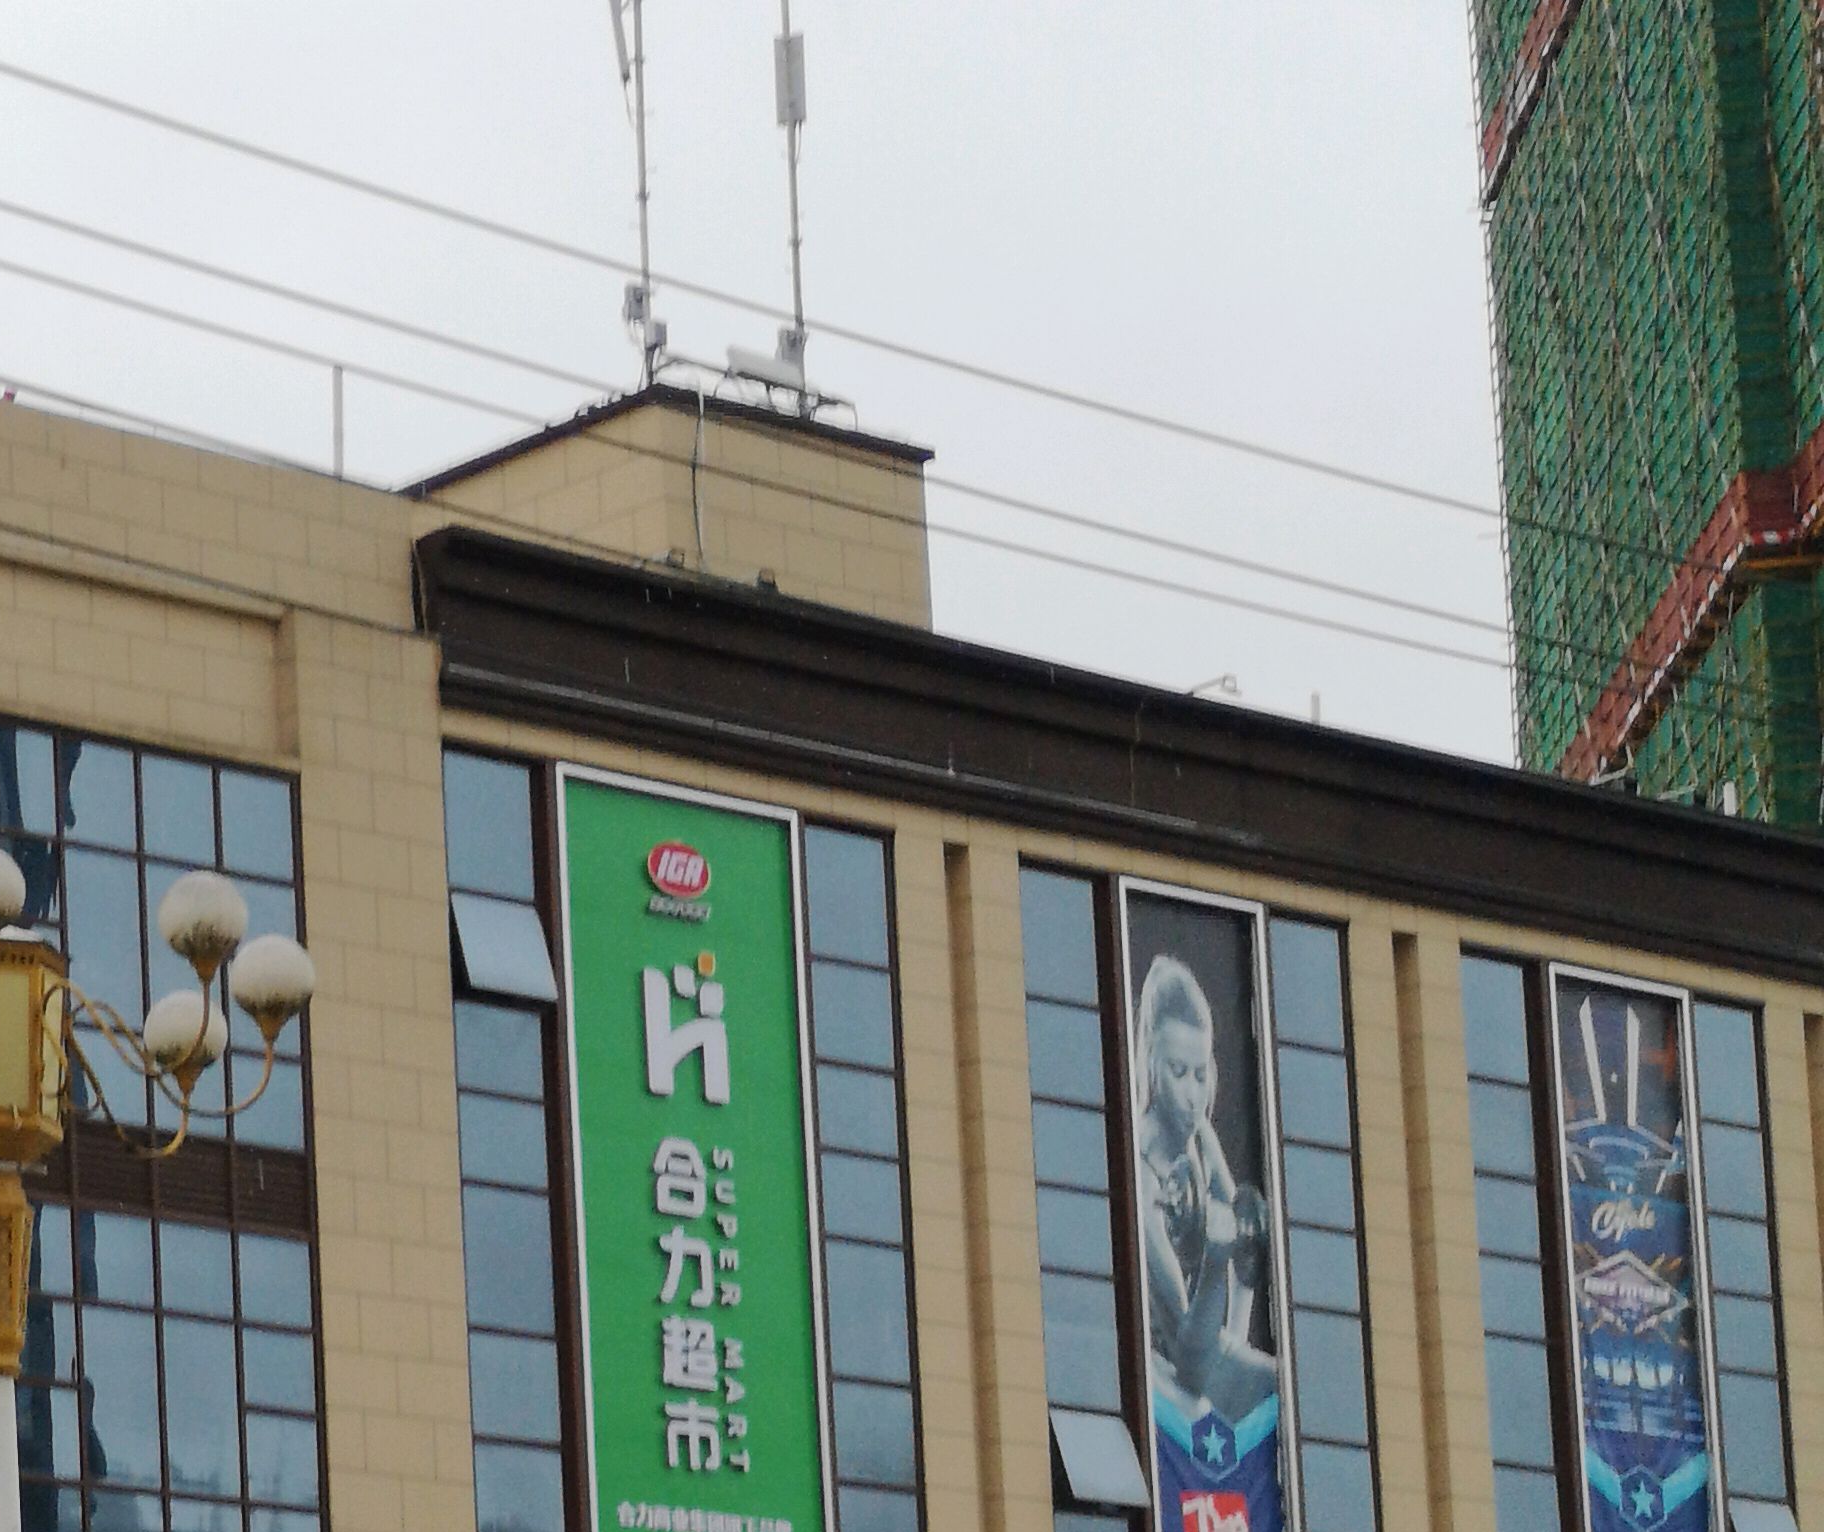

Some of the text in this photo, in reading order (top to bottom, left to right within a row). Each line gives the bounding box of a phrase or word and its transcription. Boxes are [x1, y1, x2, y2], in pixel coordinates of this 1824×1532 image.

[655, 848, 705, 888] IGA
[653, 1137, 721, 1471] 合力超市
[712, 1145, 751, 1474] SUPER MART
